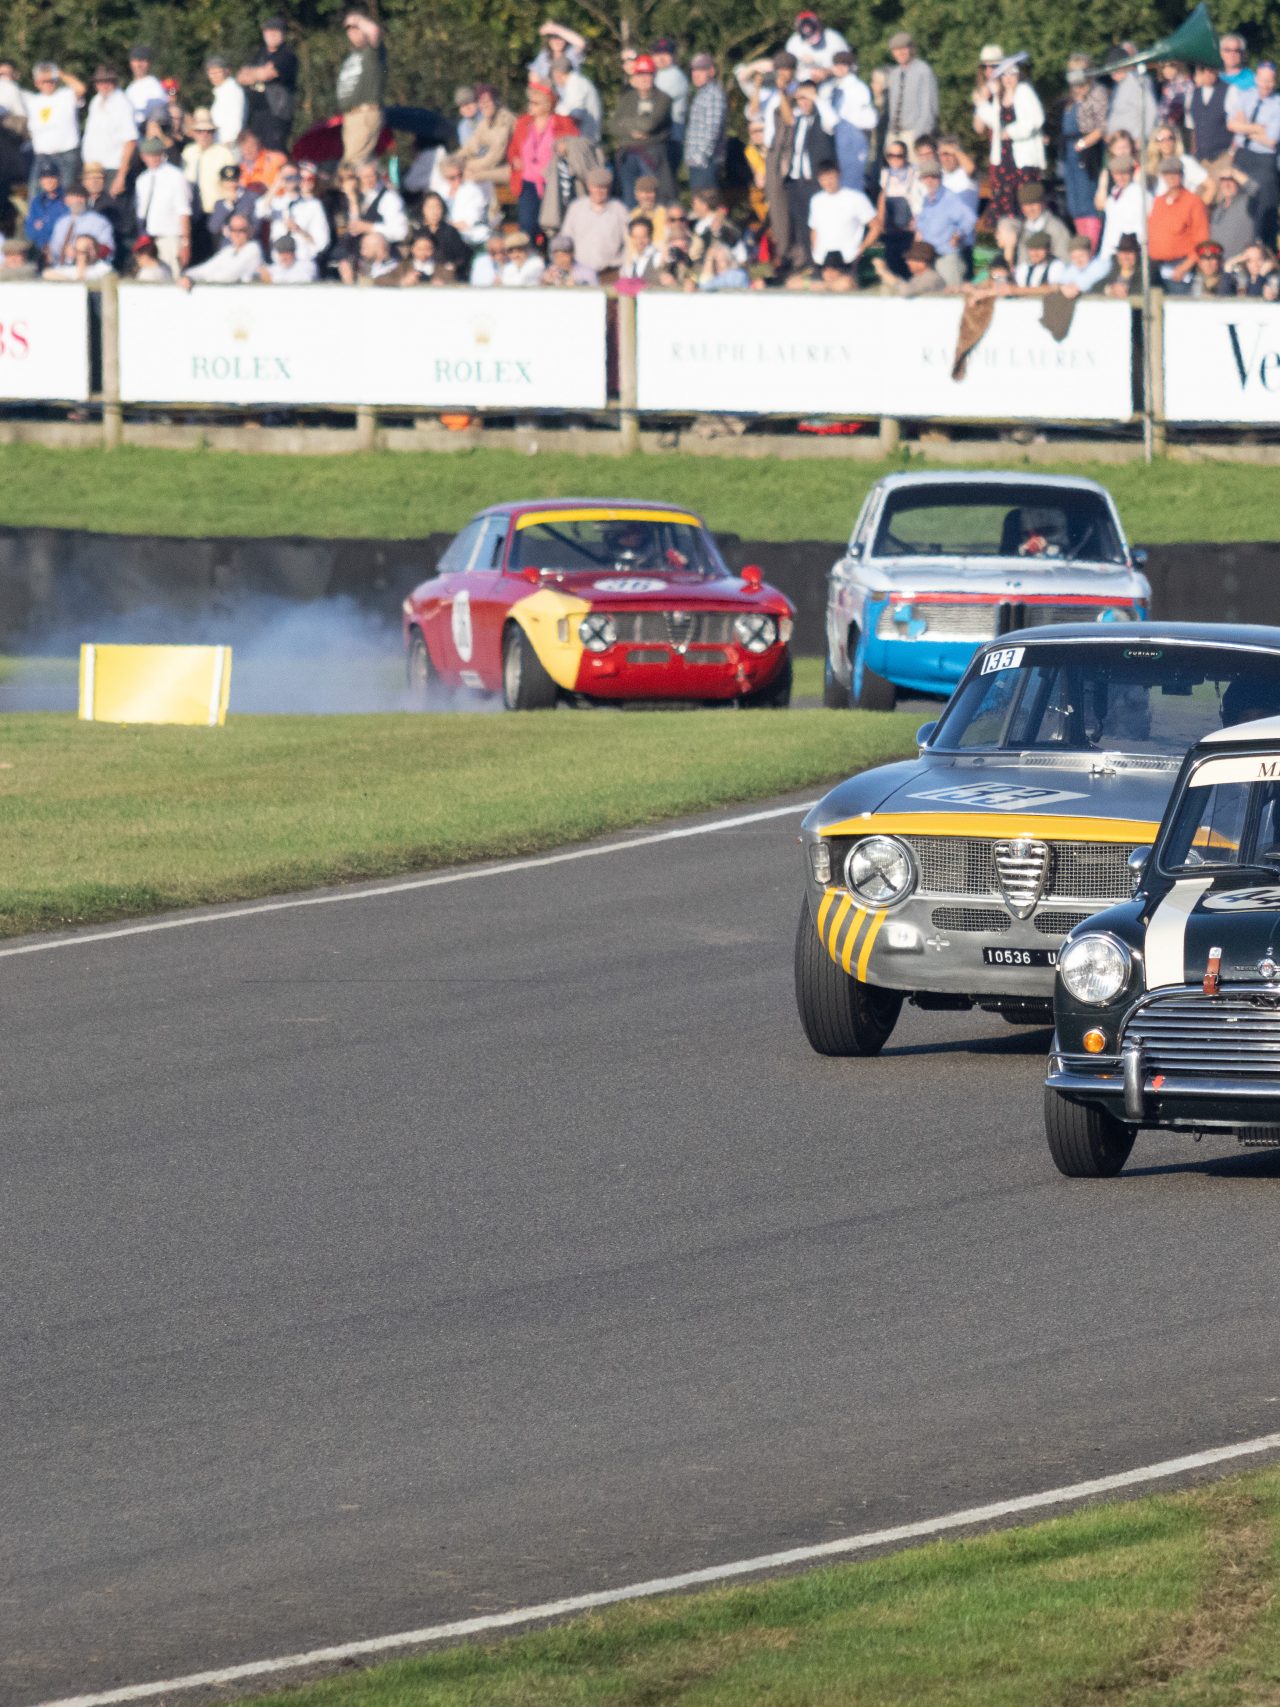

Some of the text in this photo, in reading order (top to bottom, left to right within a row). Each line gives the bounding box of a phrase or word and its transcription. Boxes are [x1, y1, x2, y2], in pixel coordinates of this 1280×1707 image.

[671, 342, 853, 363] RALPH LAUREN
[1009, 347, 1097, 368] LAUREN
[191, 355, 291, 380] ROLEX
[434, 359, 534, 384] ROLEX
[983, 649, 1016, 674] 133
[918, 782, 1062, 806] 133
[987, 949, 1032, 965] 10536
